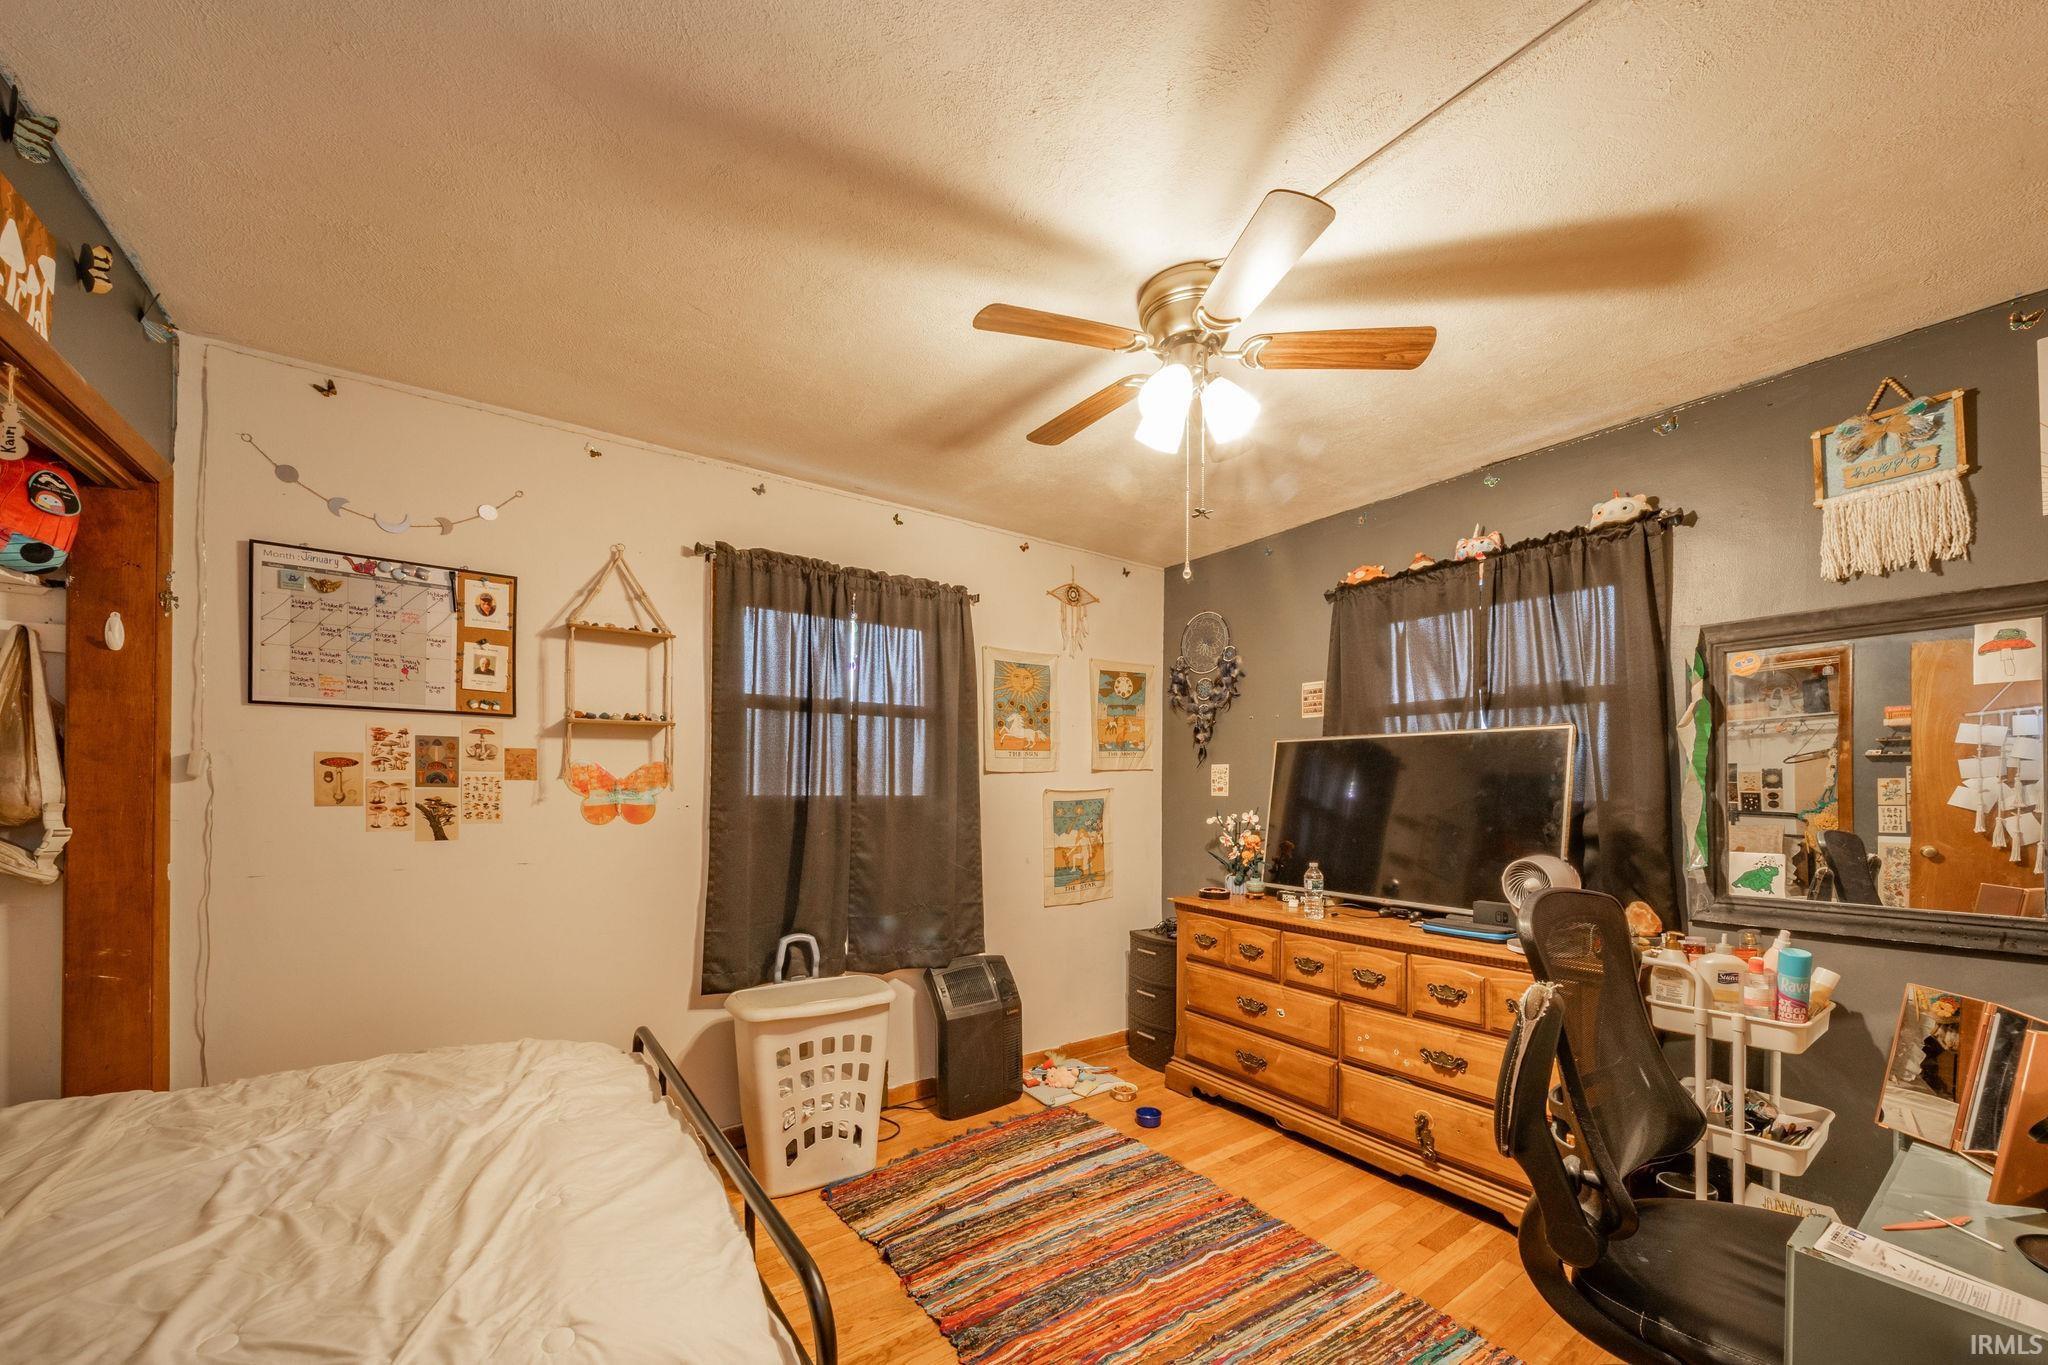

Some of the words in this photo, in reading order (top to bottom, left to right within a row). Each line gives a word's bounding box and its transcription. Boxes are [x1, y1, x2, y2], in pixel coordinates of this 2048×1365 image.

[300, 550, 340, 569] January
[1079, 882, 1097, 890] STAR
[1780, 976, 1809, 994] Rave
[1779, 1004, 1806, 1014] MEGA
[1778, 1012, 1805, 1021] HOLD
